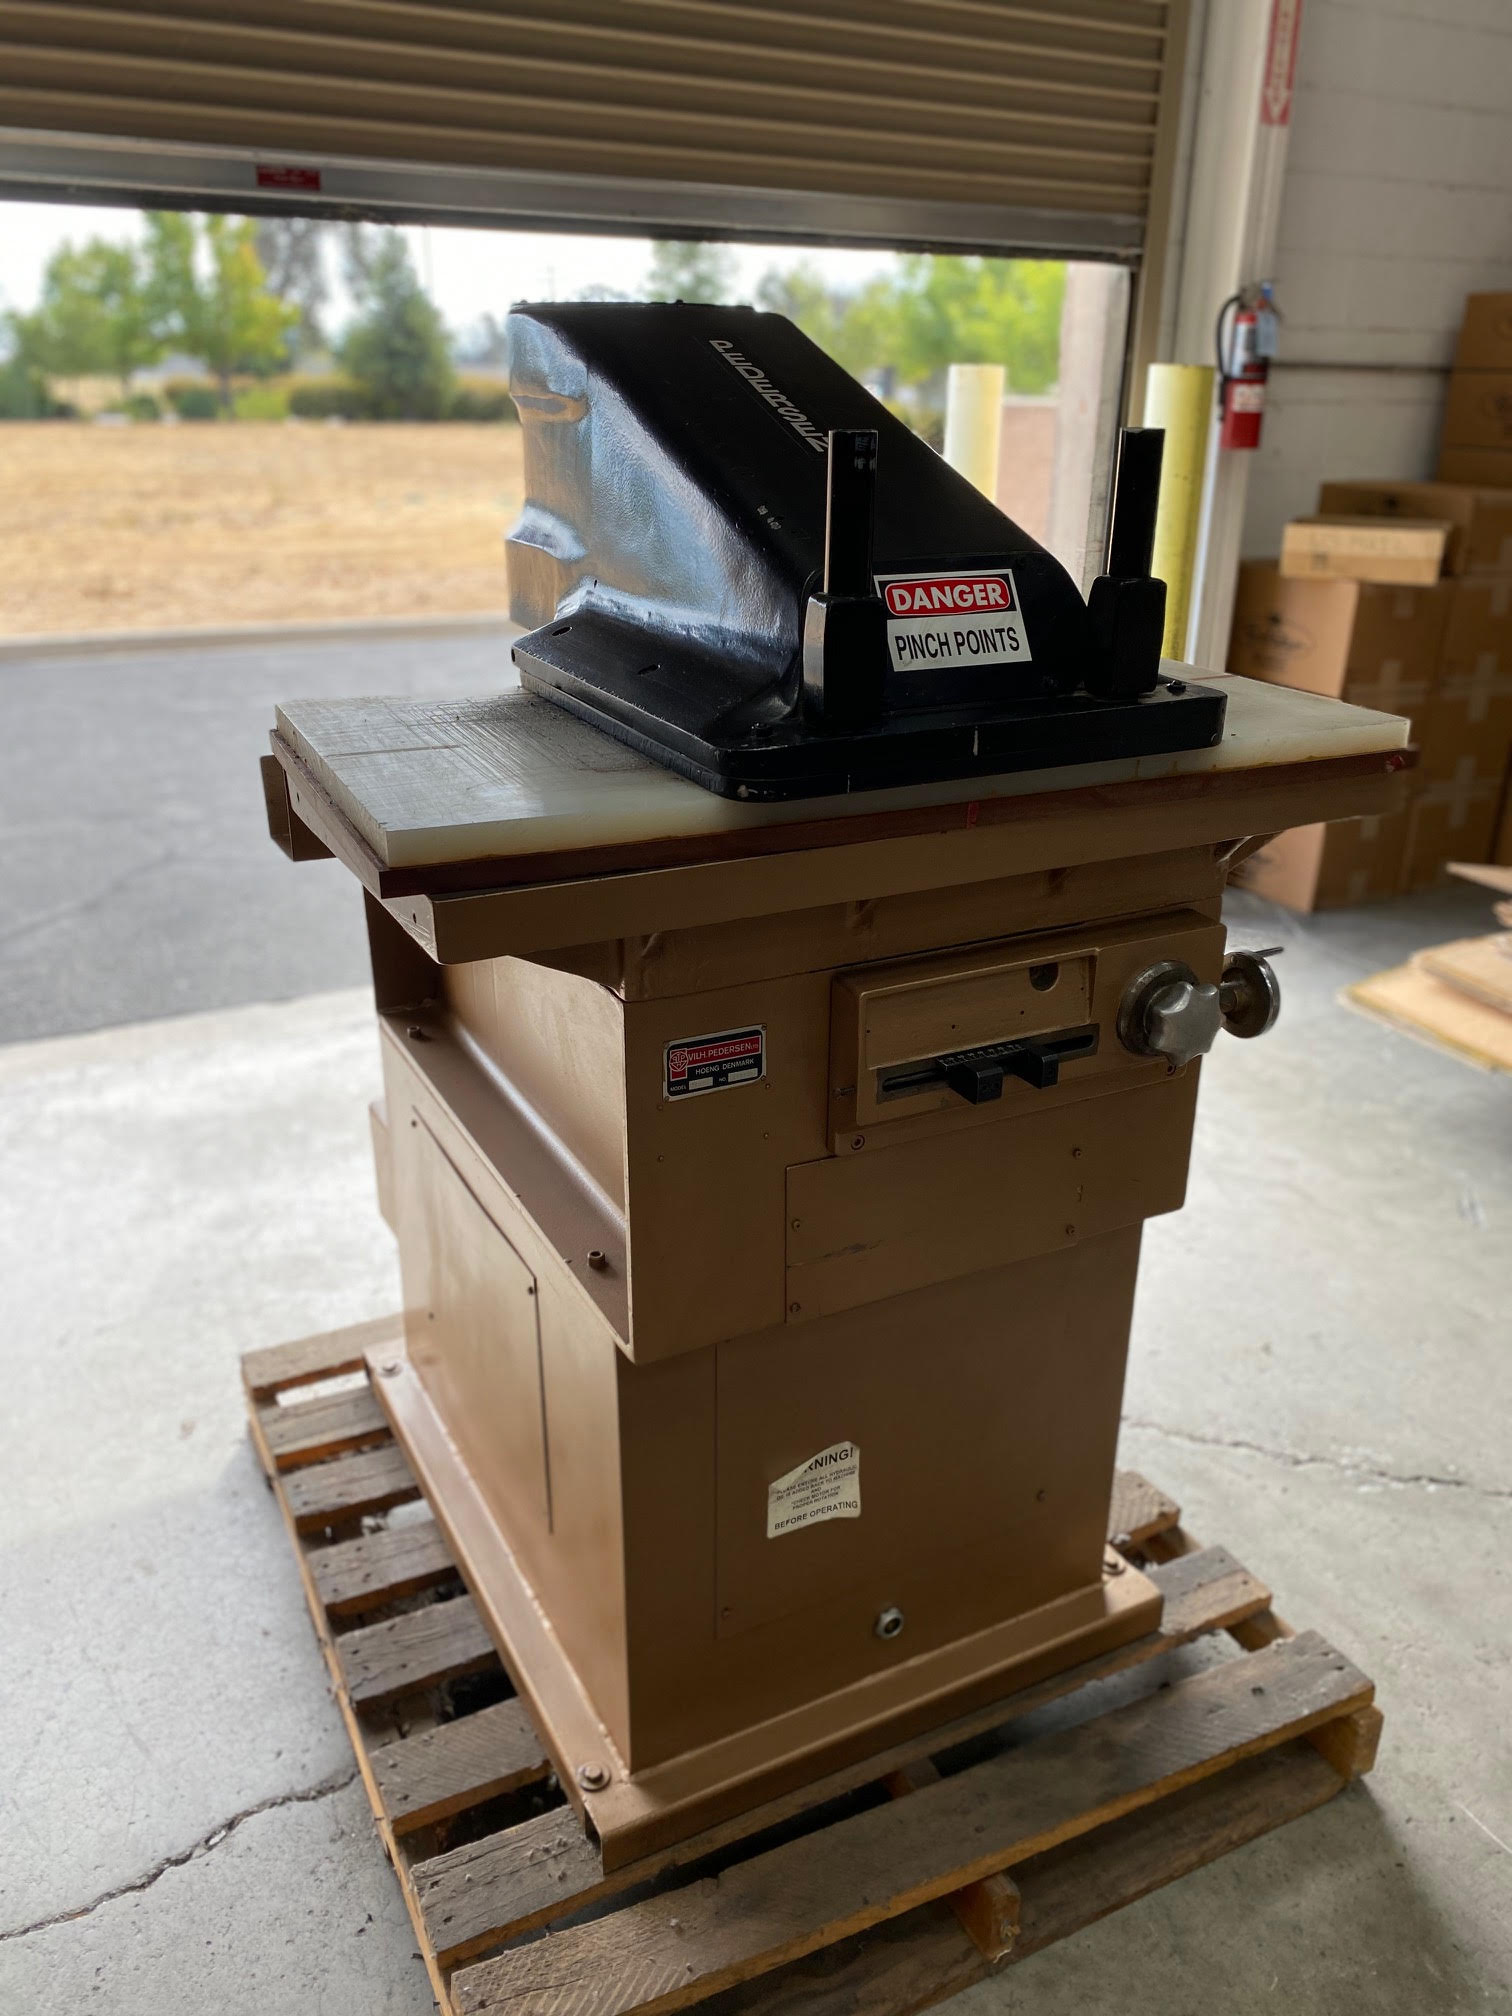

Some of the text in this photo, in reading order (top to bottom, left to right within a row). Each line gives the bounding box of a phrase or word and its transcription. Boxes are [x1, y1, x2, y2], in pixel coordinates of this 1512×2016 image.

[709, 340, 828, 453] PEDERSEN
[891, 583, 1006, 612] DANGER
[894, 627, 1020, 661] PINCH POINTS
[708, 1043, 751, 1058] PEDERSEN
[695, 1058, 755, 1076] HOENG DENMARK
[774, 1500, 858, 1530] BEFORE OPERATING
